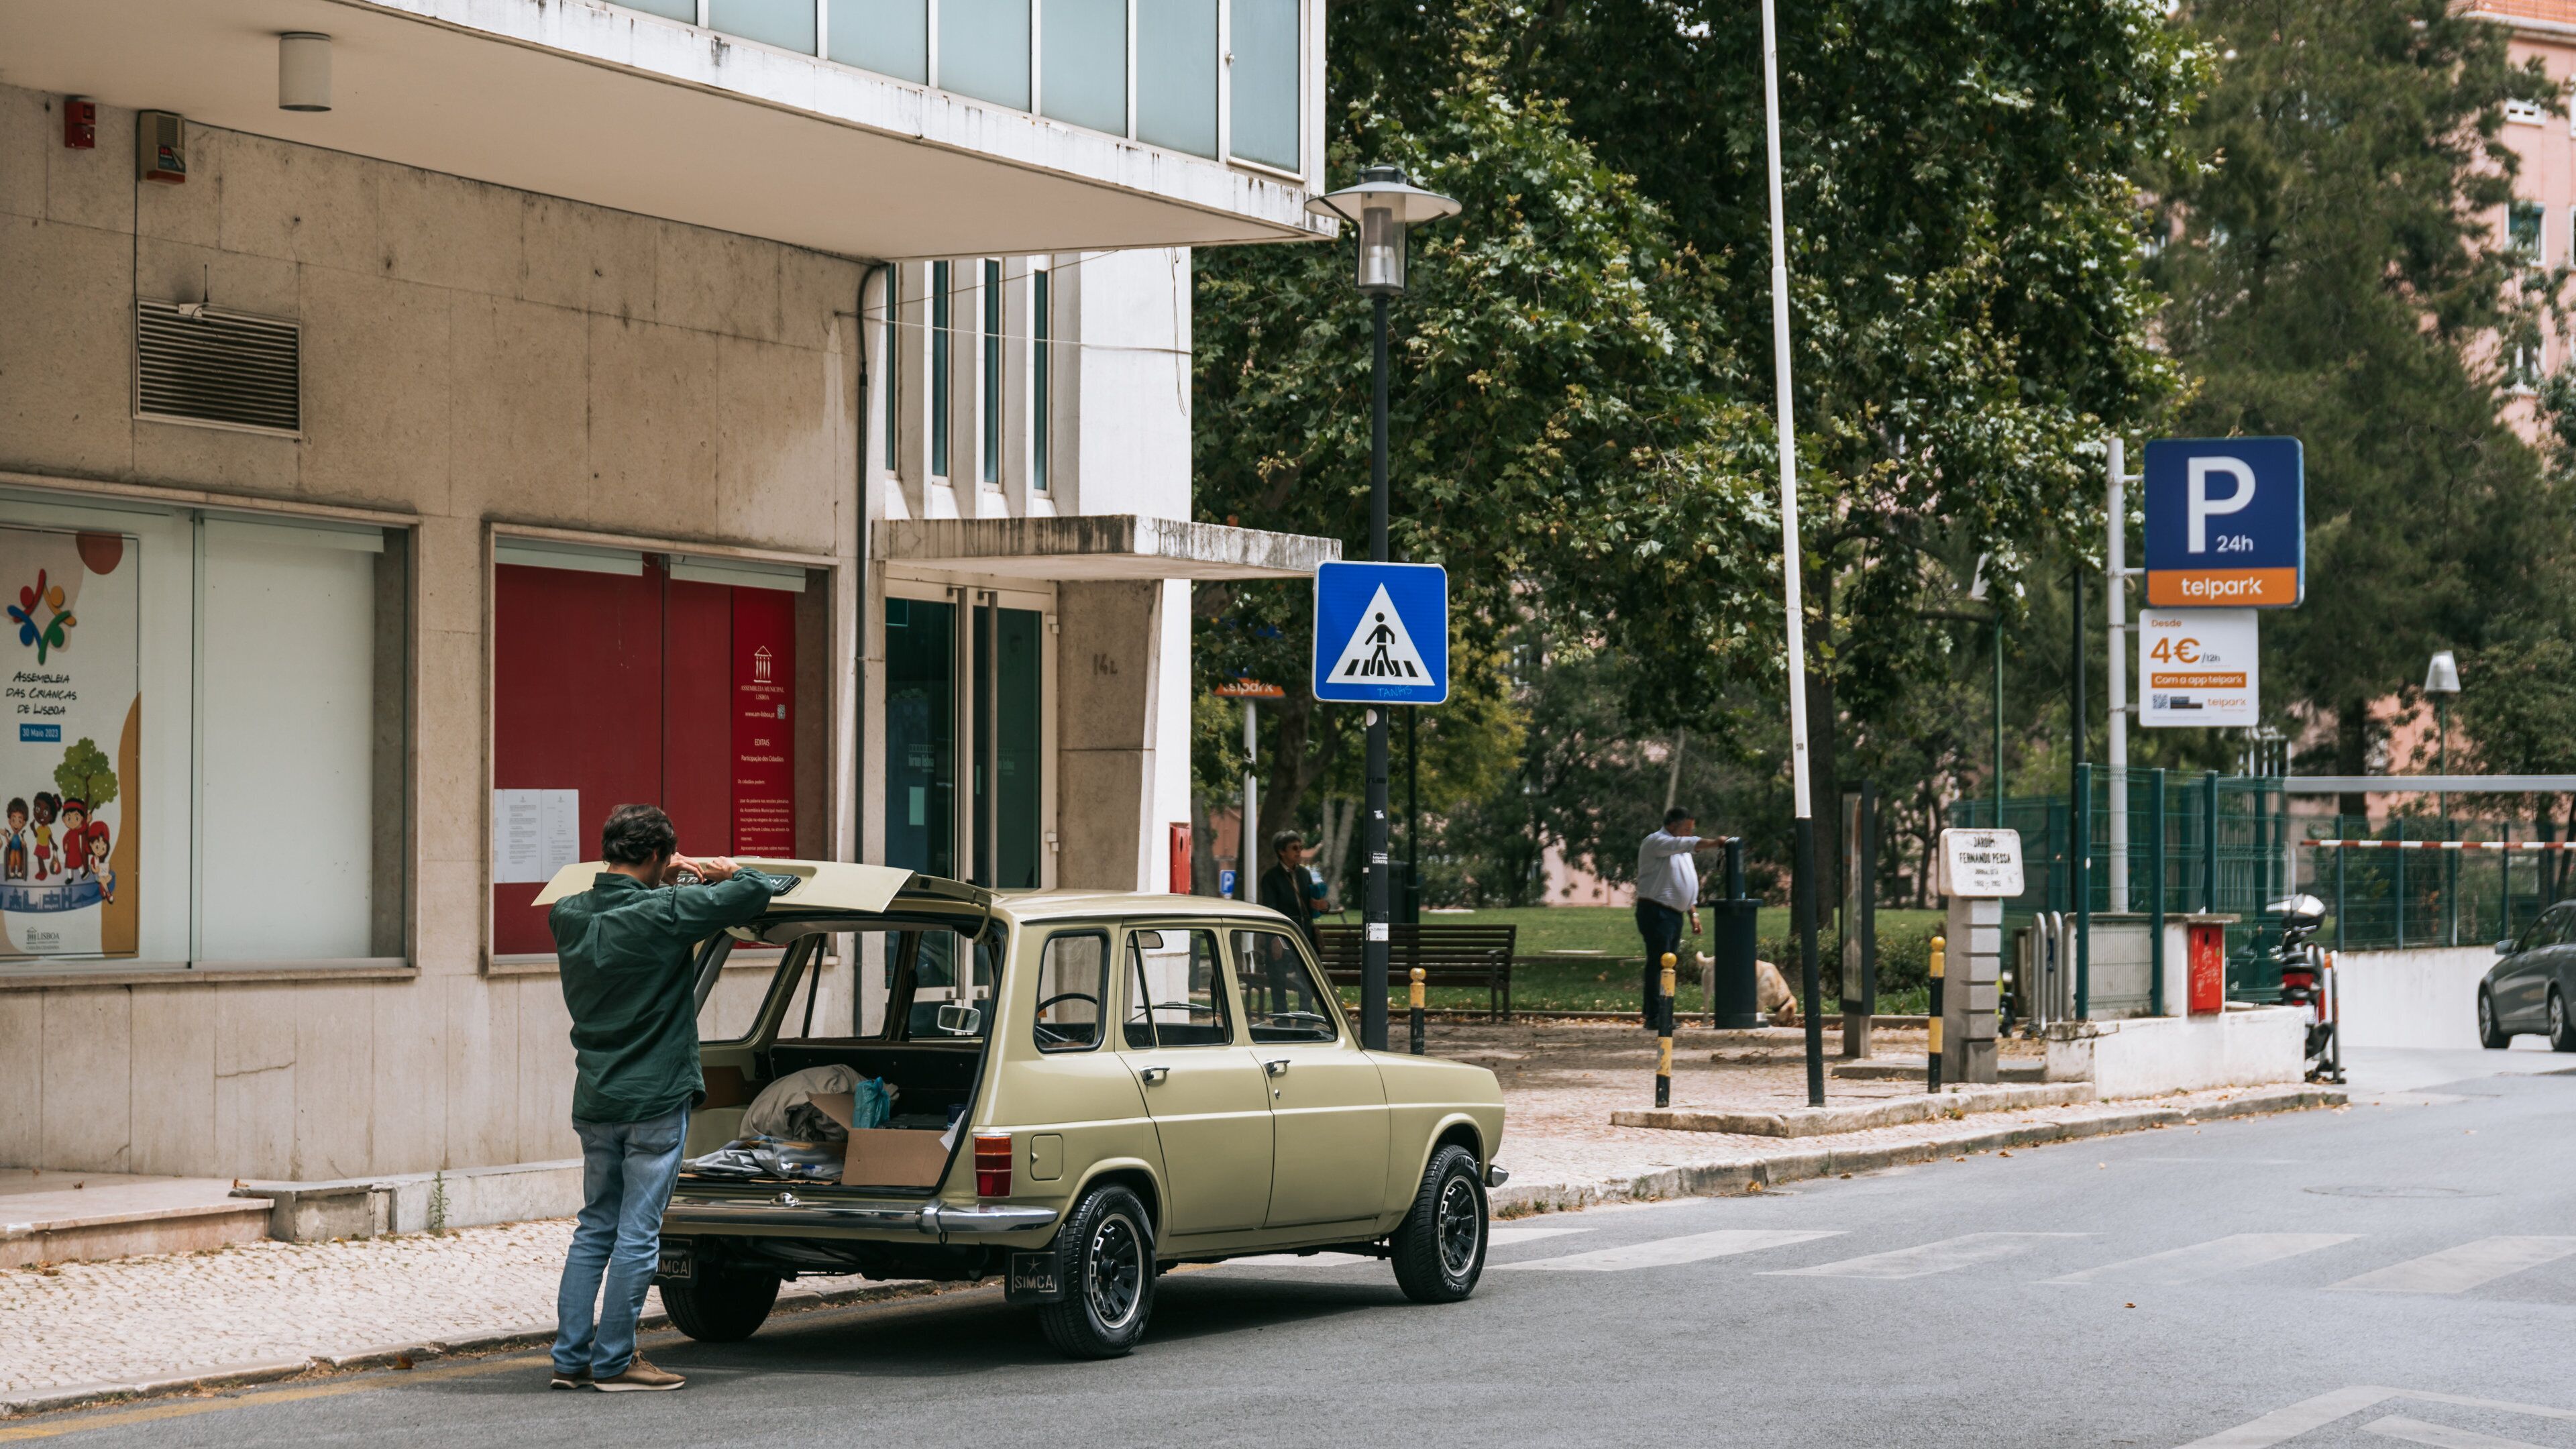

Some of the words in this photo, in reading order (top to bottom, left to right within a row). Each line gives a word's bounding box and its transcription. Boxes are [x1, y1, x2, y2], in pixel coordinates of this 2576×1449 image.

[2188, 456, 2256, 553] P
[2216, 535, 2254, 553] 24h
[2181, 577, 2263, 600] telpark
[2151, 619, 2182, 627] Desde
[2151, 637, 2200, 663] 4€
[13, 671, 70, 683] ASSEMBLEIA
[2155, 676, 2178, 685] Com
[2188, 678, 2208, 687] app
[2208, 676, 2243, 686] telpark
[6, 688, 25, 698] DAS
[29, 687, 77, 700] CRIANÇAS
[17, 704, 30, 714] DE
[33, 702, 66, 715] LISBOA
[2207, 697, 2247, 708] telpark
[22, 728, 30, 737] 30
[31, 728, 44, 737] Maio
[45, 728, 58, 738] 2023
[1960, 852, 1990, 864] FERNANDO
[1992, 853, 2011, 864] PESSA
[1224, 873, 1234, 891] P
[37, 932, 60, 940] LISBOA
[659, 1259, 688, 1274] IMCA
[1014, 1275, 1053, 1289] SIMCA
